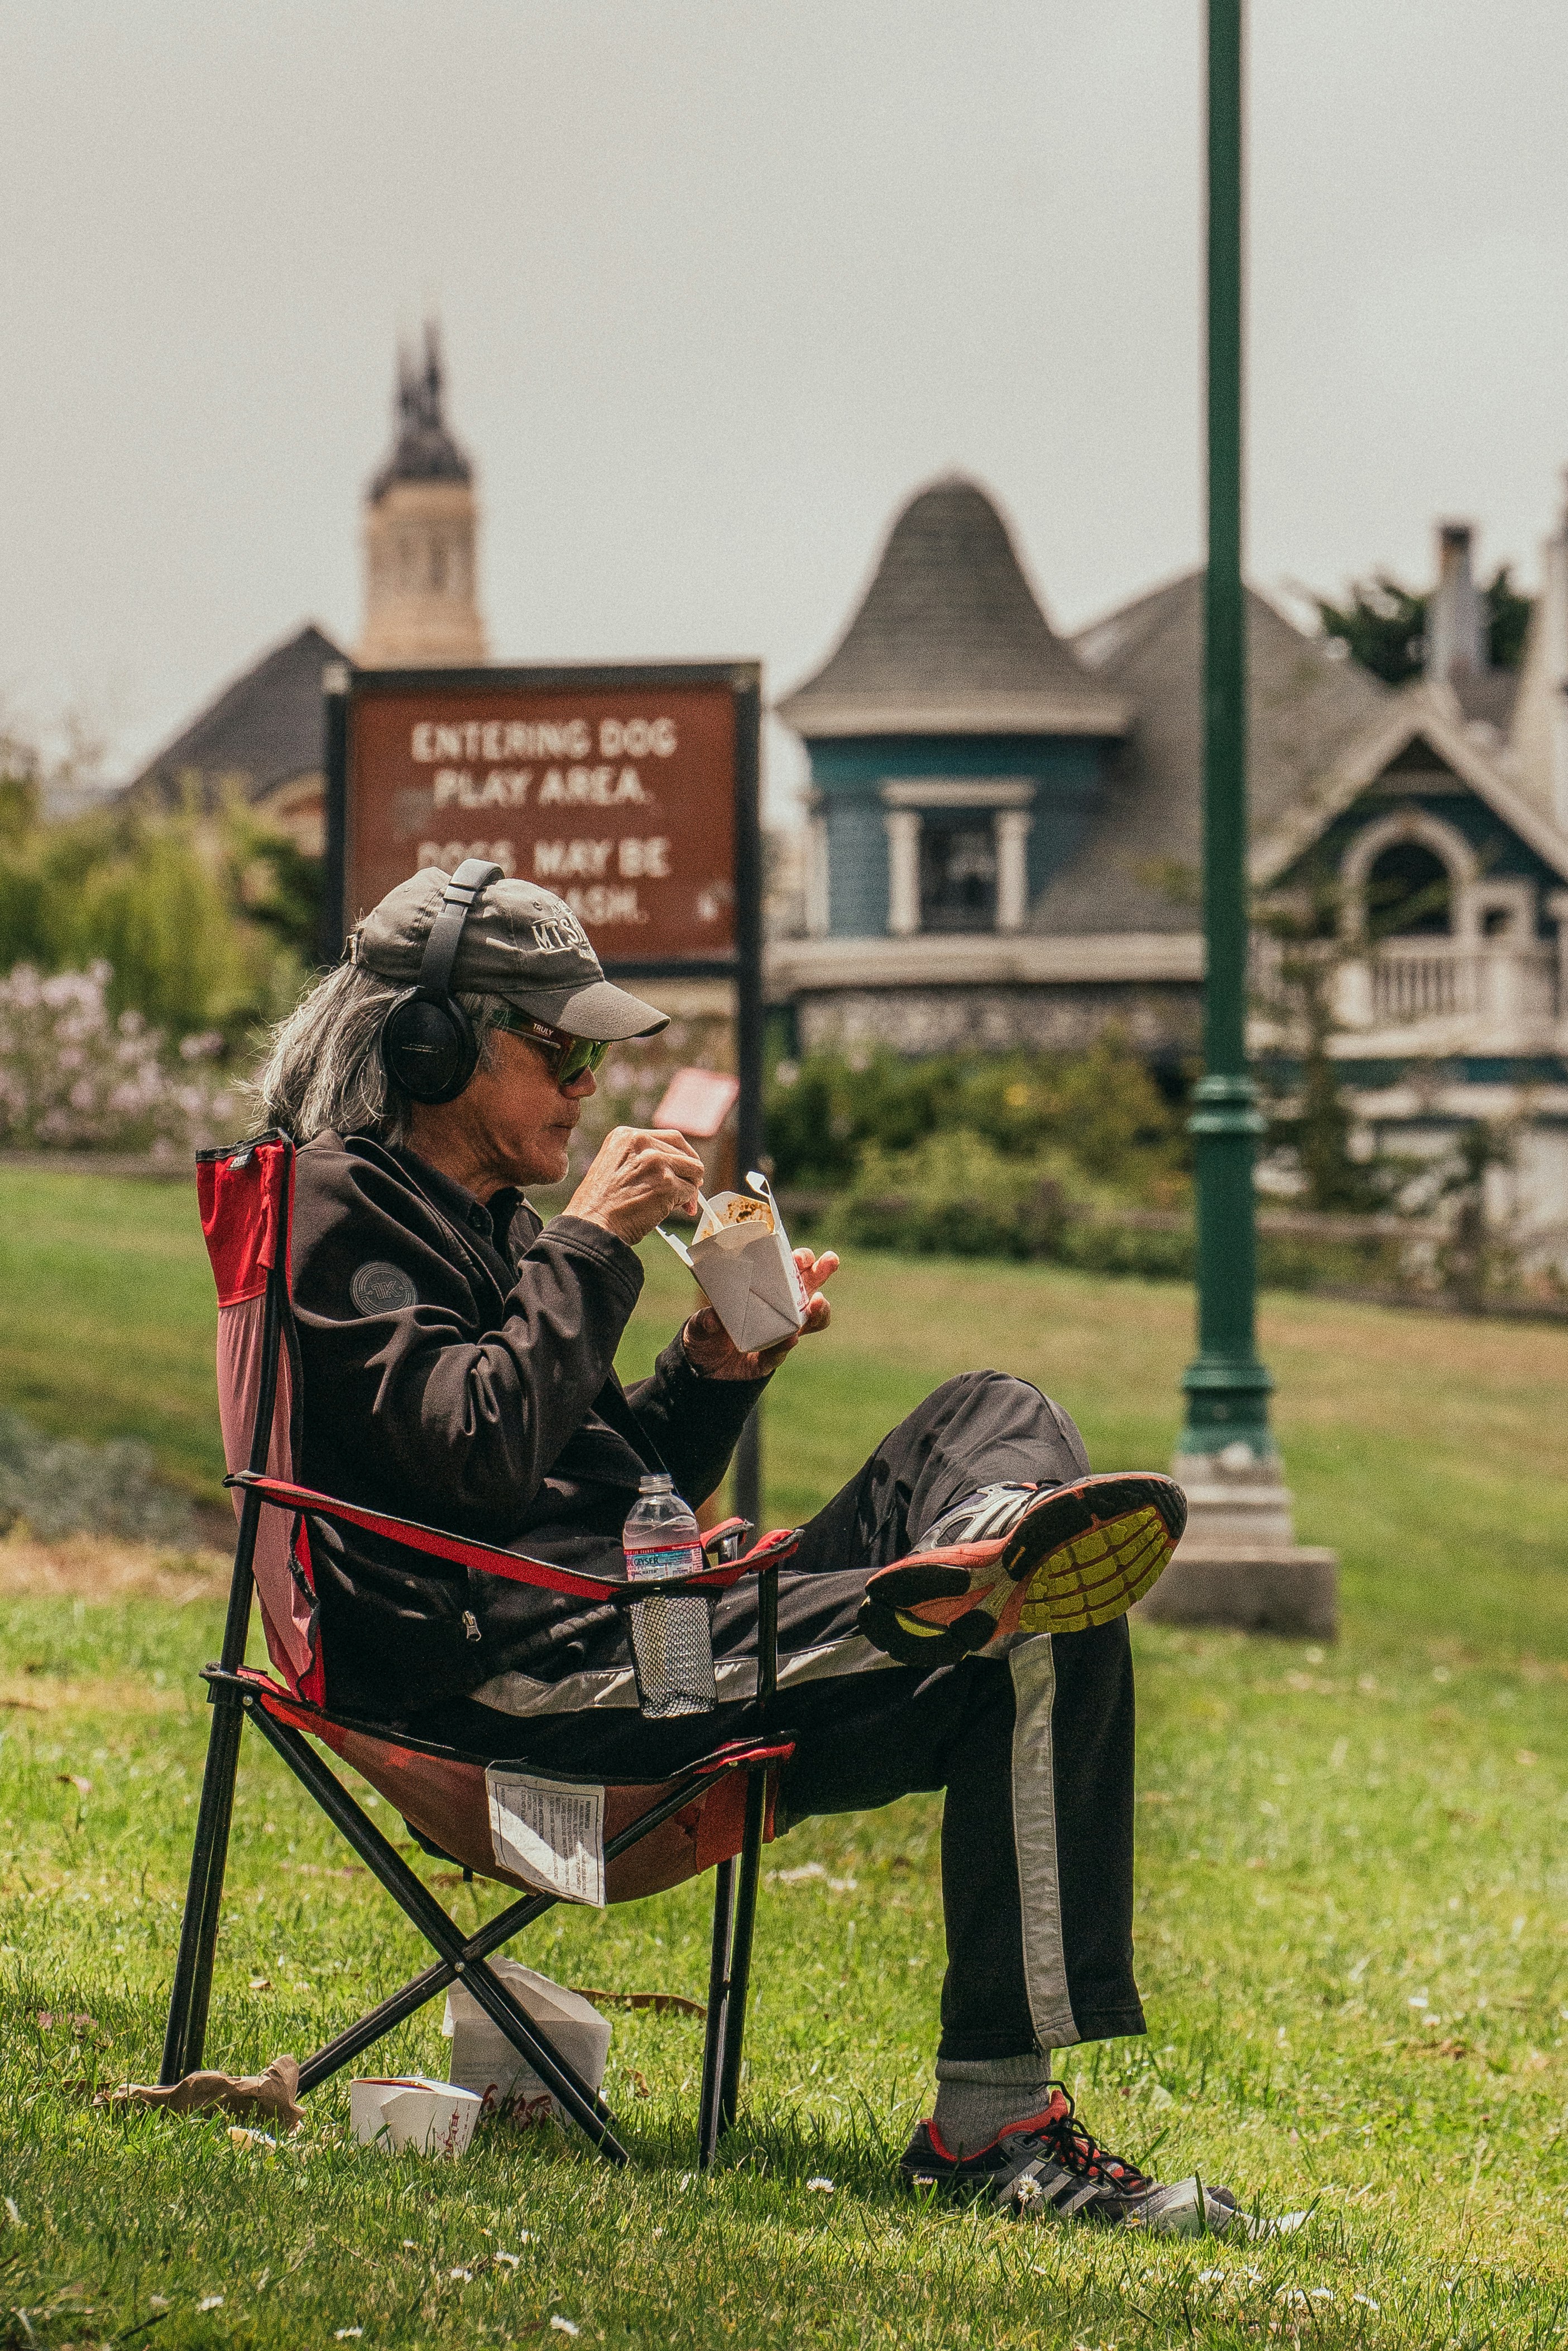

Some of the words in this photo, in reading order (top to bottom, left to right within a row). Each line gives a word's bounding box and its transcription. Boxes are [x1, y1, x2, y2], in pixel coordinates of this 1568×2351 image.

[411, 719, 591, 763] ENTERING
[598, 717, 677, 759] DOG
[433, 767, 533, 809] PLAY
[534, 837, 613, 877] MAY
[617, 836, 672, 878] BE
[533, 1023, 554, 1036] TRULY
[634, 1557, 659, 1566] GEYSER
